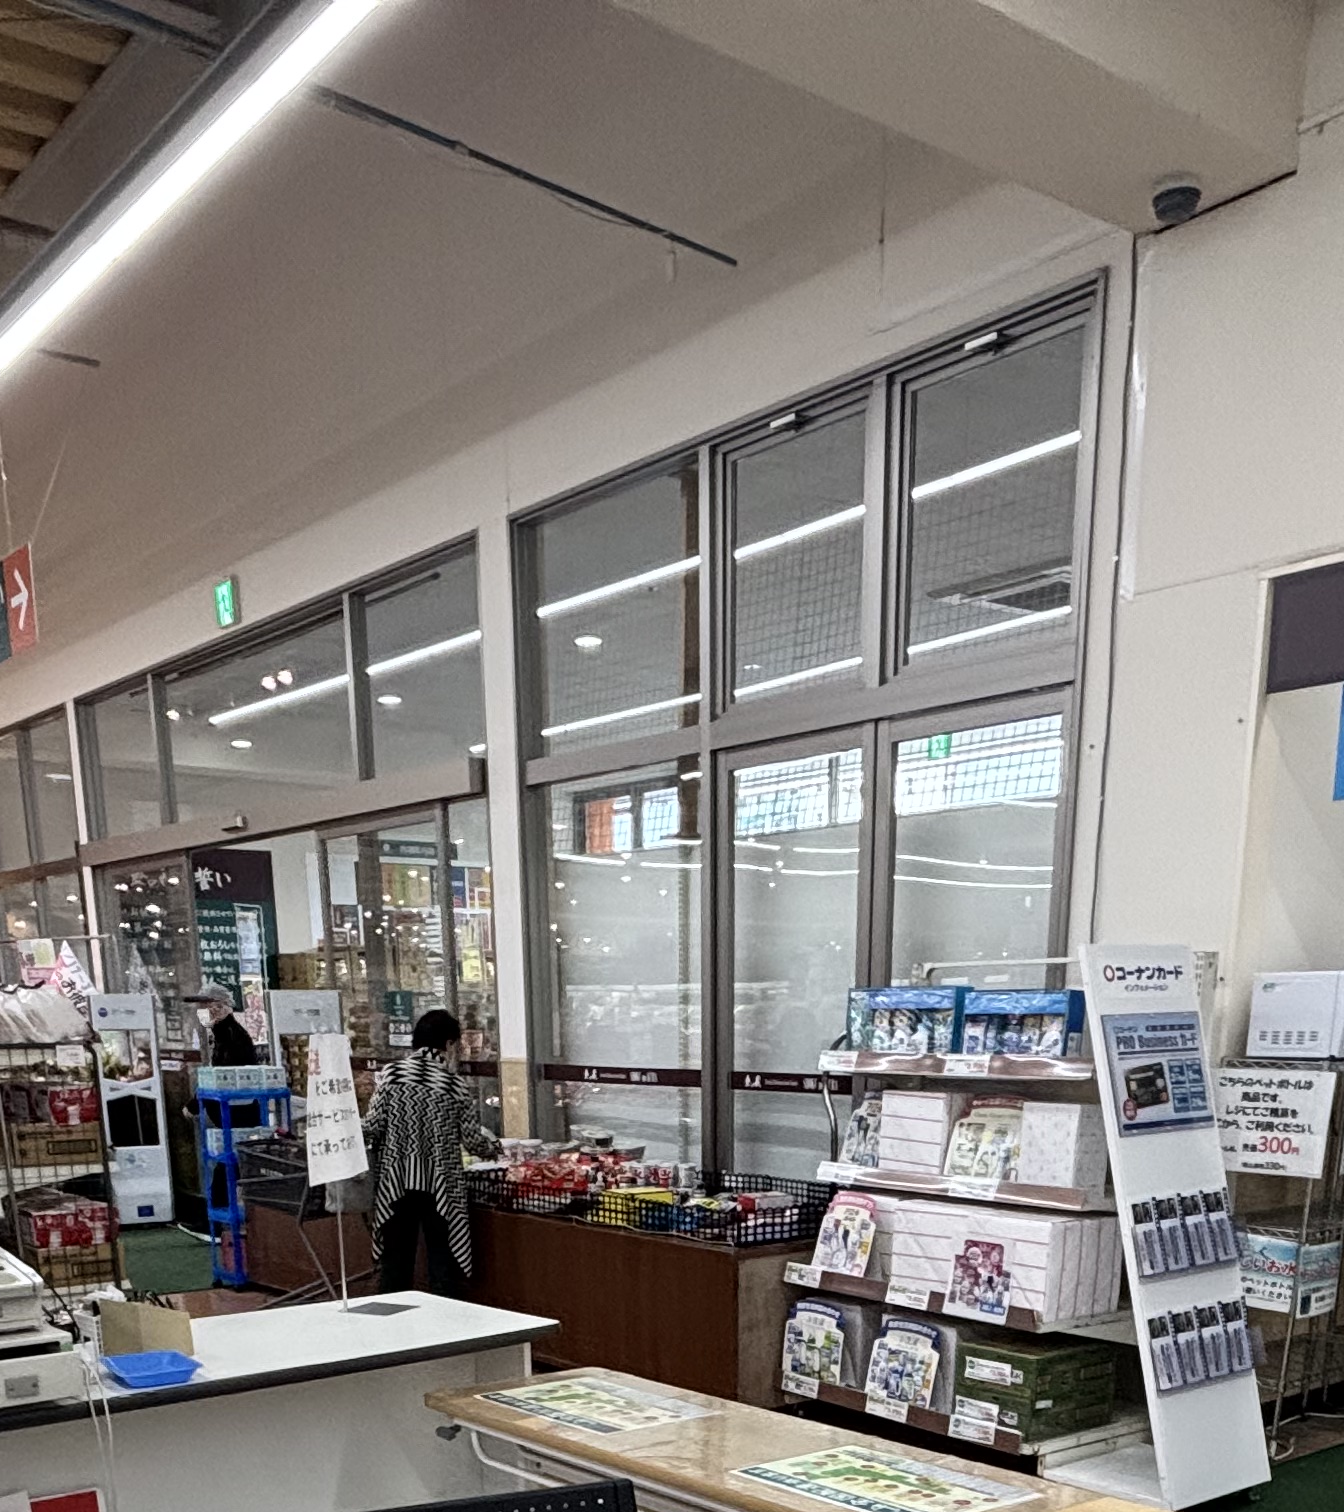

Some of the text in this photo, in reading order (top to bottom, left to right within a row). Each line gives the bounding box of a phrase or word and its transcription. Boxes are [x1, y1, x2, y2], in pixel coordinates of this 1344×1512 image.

[1115, 965, 1183, 981] コーナンカード
